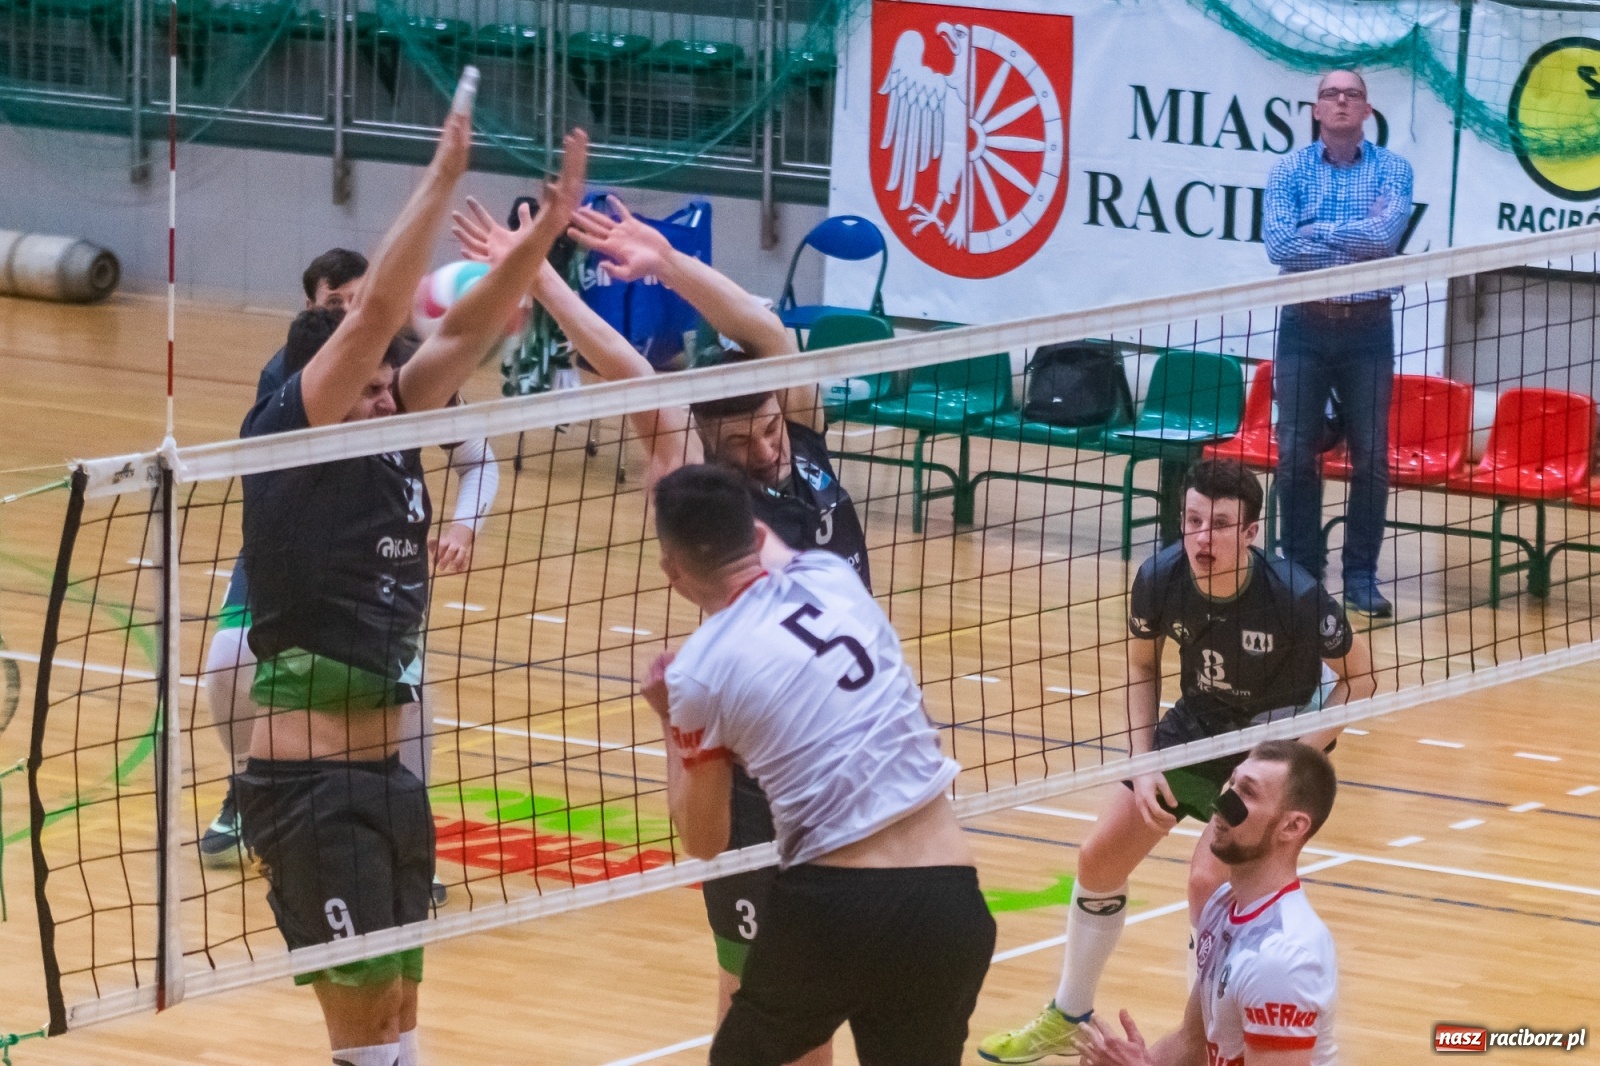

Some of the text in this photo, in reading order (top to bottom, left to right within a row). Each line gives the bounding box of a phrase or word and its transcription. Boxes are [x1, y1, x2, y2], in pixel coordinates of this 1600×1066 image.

[1127, 84, 1389, 155] MIAST
[1083, 170, 1430, 256] RACIZ
[780, 602, 875, 692] 5
[1202, 649, 1225, 681] 8
[324, 897, 356, 941] 9
[735, 899, 758, 940] 3
